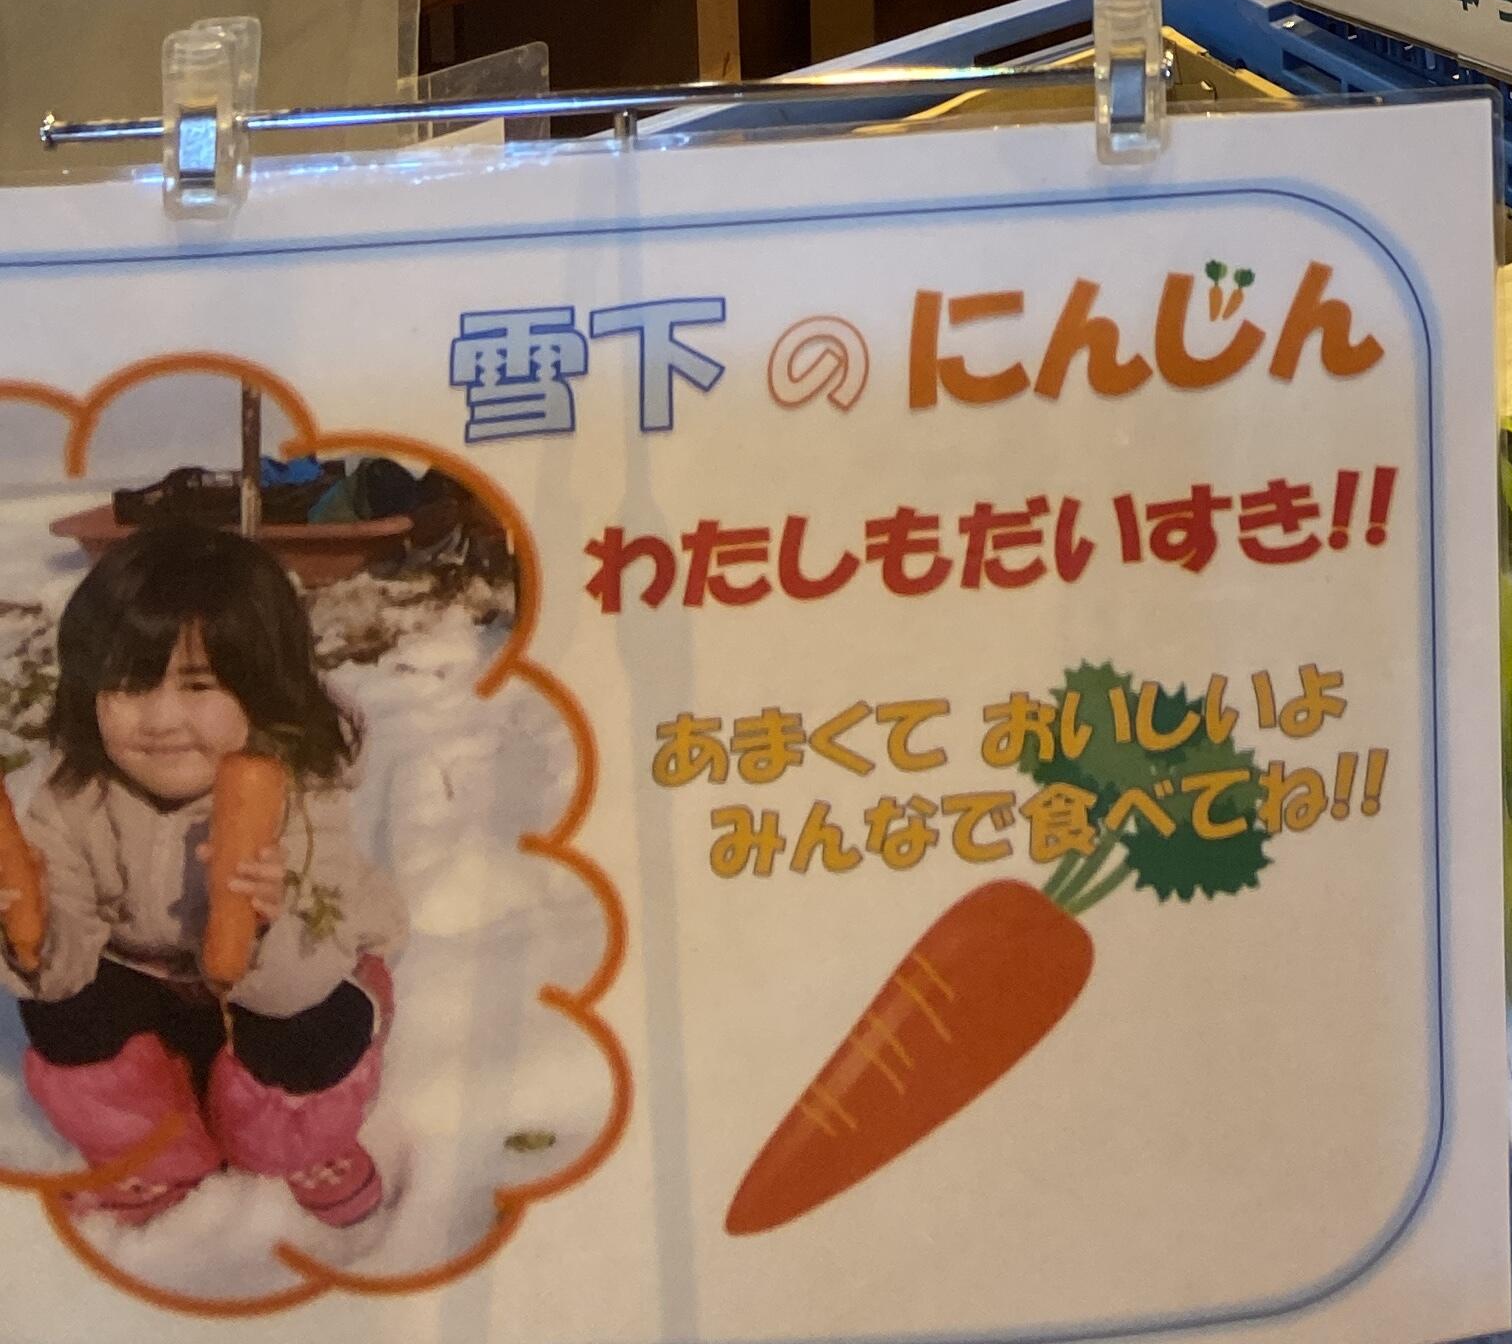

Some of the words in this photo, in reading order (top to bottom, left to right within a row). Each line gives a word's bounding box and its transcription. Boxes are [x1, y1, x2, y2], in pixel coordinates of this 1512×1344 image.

[584, 466, 1398, 613] わたしもだいすき!!
[652, 698, 950, 787] あまくて
[981, 663, 1347, 766] おいしいよ
[708, 748, 1389, 877] みんなで食べてね!!
